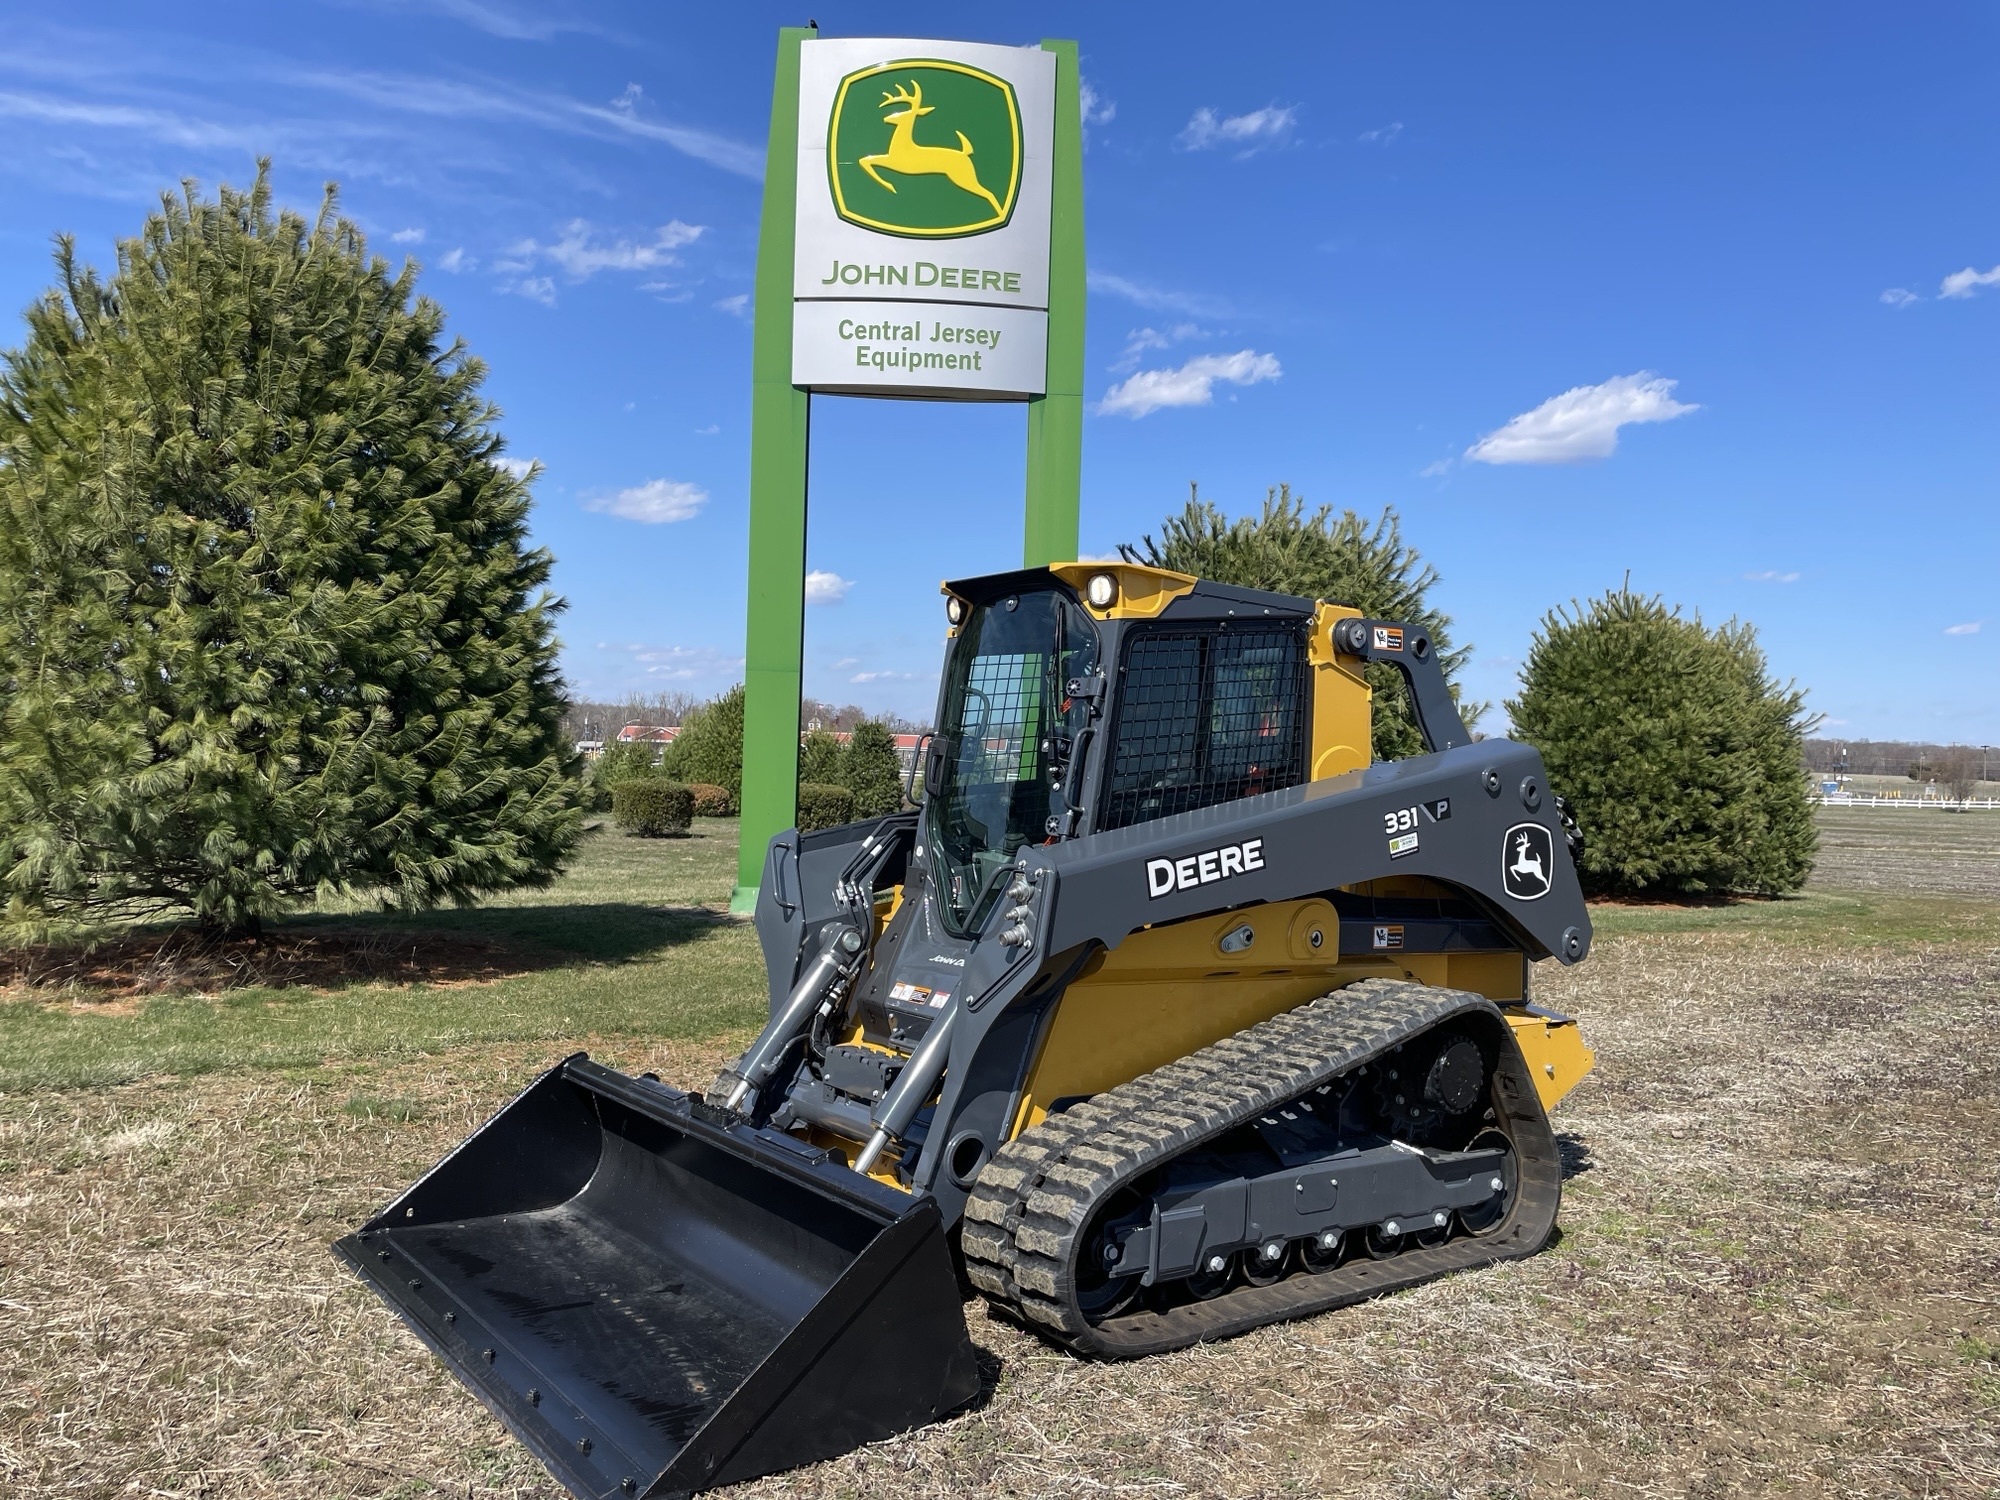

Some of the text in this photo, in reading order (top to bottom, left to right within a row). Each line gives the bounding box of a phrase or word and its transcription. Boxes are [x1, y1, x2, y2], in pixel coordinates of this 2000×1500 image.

[822, 260, 1021, 293] JOHN DEERE
[838, 319, 1002, 350] Central Jersey
[856, 346, 982, 372] Equipment
[1384, 806, 1419, 835] 331
[1146, 839, 1265, 898] DEERE
